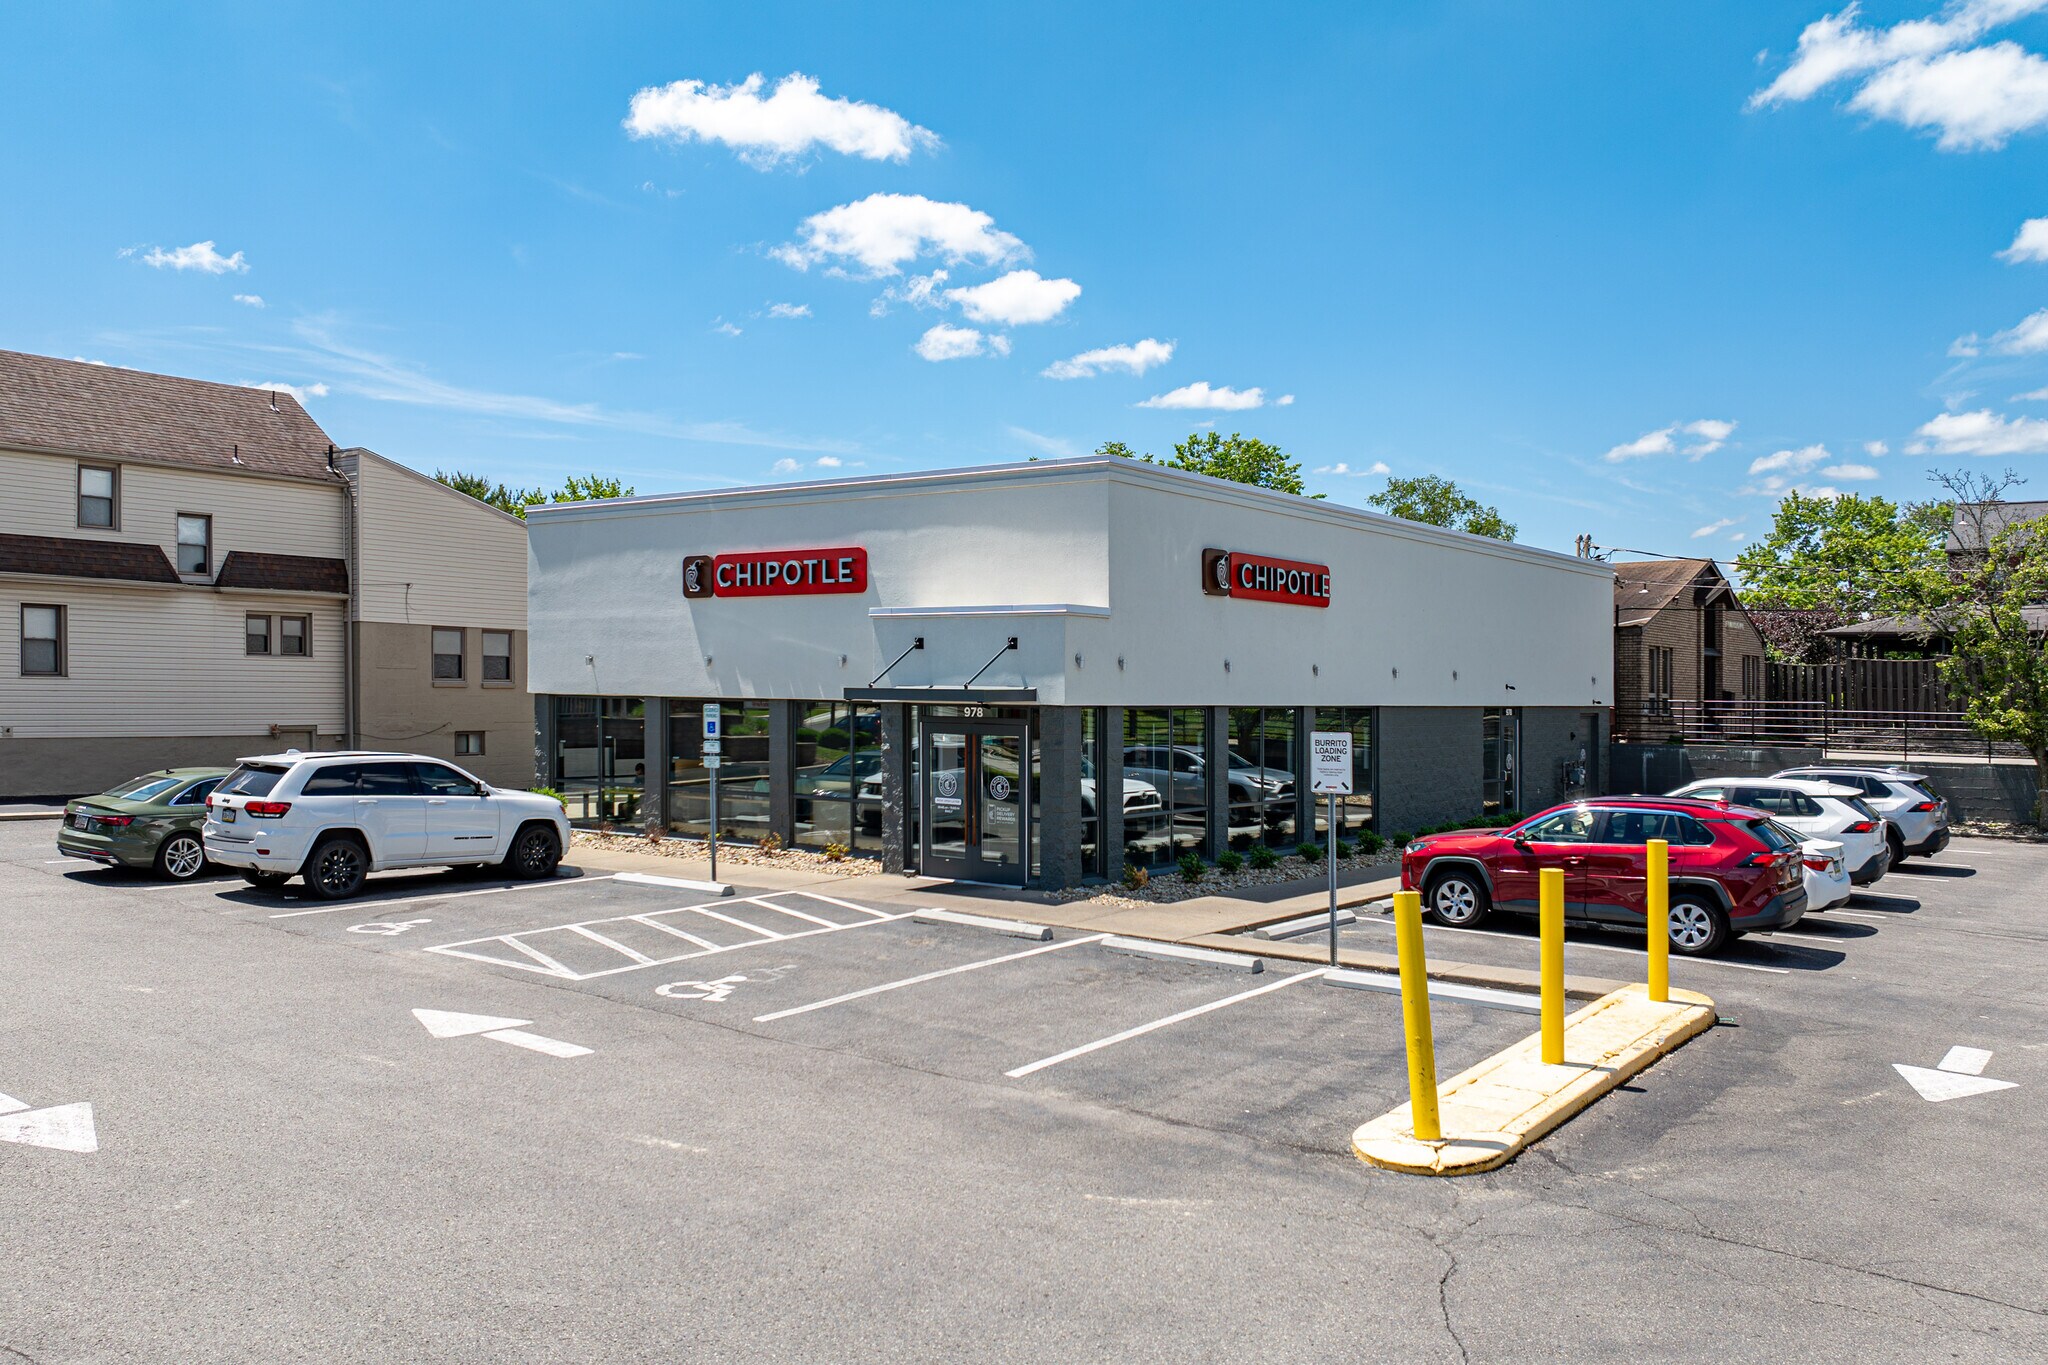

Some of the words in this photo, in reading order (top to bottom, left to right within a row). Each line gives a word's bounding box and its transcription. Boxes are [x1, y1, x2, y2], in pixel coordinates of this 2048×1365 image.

[716, 557, 853, 587] CHIPOTLE
[1241, 563, 1330, 597] CHIPOTLE
[964, 706, 983, 717] 978
[1314, 747, 1347, 755] LOADING
